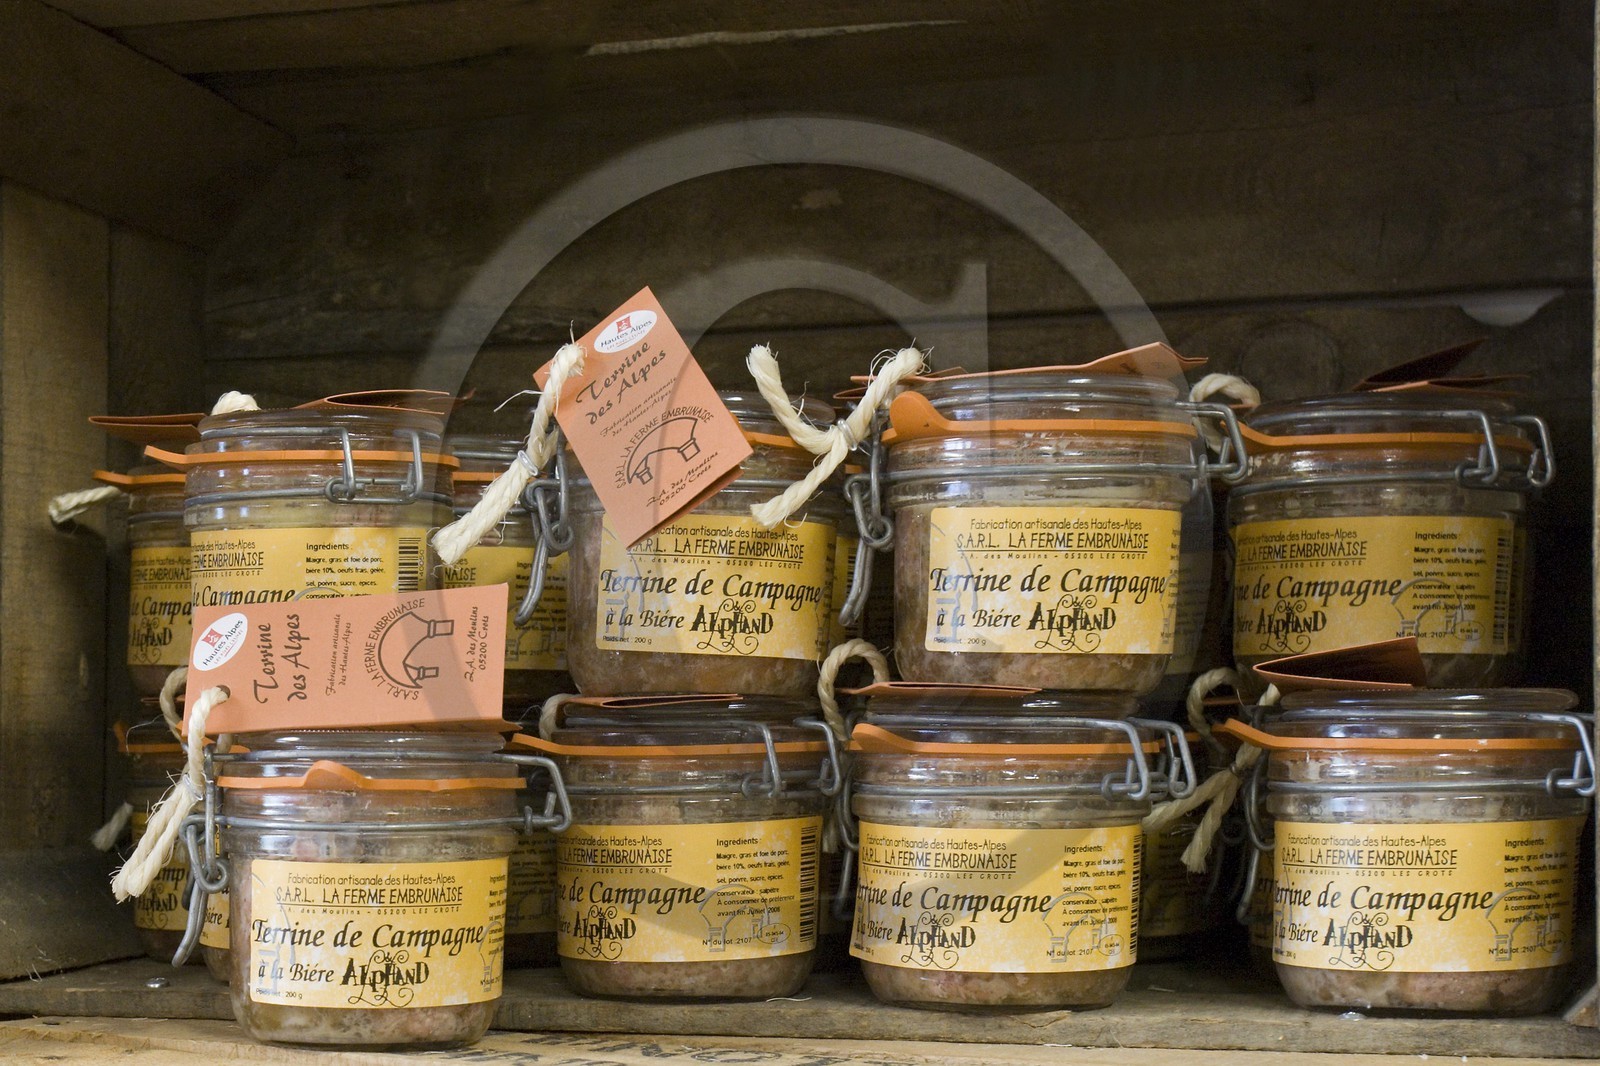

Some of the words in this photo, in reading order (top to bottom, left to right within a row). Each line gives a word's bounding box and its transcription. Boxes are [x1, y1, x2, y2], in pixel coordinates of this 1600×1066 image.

[600, 332, 629, 348] Hautes
[630, 320, 653, 335] Alpes
[575, 341, 651, 404] Terrine
[585, 398, 613, 424] des
[617, 350, 667, 404] Alpes
[600, 404, 642, 438] Fabrication
[643, 377, 677, 405] artisanale
[661, 406, 714, 424] EMBRUNAISE
[630, 418, 659, 444] FERME
[620, 446, 634, 459] LA
[615, 459, 627, 490] SARL
[684, 452, 719, 482] Moulins
[659, 484, 687, 506] 05200
[688, 464, 712, 484] Crots
[689, 525, 734, 538] artisanale
[735, 528, 750, 538] des
[751, 529, 798, 544] Hautes-Alpes
[970, 518, 1022, 531] Fabrication
[1024, 518, 1071, 530] artisanale
[1072, 518, 1089, 530] des
[1091, 518, 1142, 533] Hautes-Alpes
[1287, 531, 1300, 542] des
[1301, 528, 1358, 542] Hautes-Alpes
[214, 539, 256, 552] Hautes-Alpes
[674, 538, 693, 554] LA
[695, 539, 735, 556] FERME
[738, 539, 804, 560] EMBRUNAISE
[957, 533, 1000, 549] S.A.R.L.
[1008, 533, 1027, 549] LA
[1031, 533, 1074, 549] FERME
[1077, 533, 1149, 549] EMBRUNAISE
[1258, 545, 1287, 561] FERME
[1290, 541, 1367, 559] EMBRUNAISE
[208, 551, 265, 568] EMBRUNAISE
[600, 569, 677, 595] Terrine
[684, 569, 714, 596] de
[722, 574, 822, 611] Campagne
[930, 567, 1012, 592] Terrine
[1020, 564, 1051, 592] de
[1060, 568, 1167, 604] Campagne
[1252, 574, 1269, 600] de
[1277, 576, 1402, 607] Campagne
[368, 598, 426, 641] EMBRUNAISE
[467, 606, 478, 642] Moulins
[478, 615, 489, 640] Crots
[605, 607, 614, 626] à
[620, 607, 633, 626] la
[936, 608, 945, 626] à
[951, 606, 965, 626] la
[202, 641, 226, 666] Hautes
[224, 620, 243, 640] Alpes
[281, 613, 310, 670] Alpes
[253, 622, 279, 704] Terrine
[325, 653, 339, 697] Fabrication
[333, 613, 342, 650] artisanale
[364, 641, 378, 674] FERME
[479, 641, 488, 671] 05200
[287, 674, 308, 701] des
[371, 671, 386, 688] LA
[387, 682, 420, 701] SARL
[610, 835, 662, 849] Hautes-Alpes
[866, 833, 893, 847] Fabrication
[893, 837, 928, 849] artisanale
[930, 838, 945, 850] des
[947, 839, 1007, 853] Hautes-Alpes
[1288, 833, 1320, 846] Fabrication
[1321, 835, 1360, 847] artisanale
[1362, 836, 1379, 847] des
[1381, 835, 1447, 850] Hautes-Alpes
[574, 848, 599, 863] FERME
[601, 848, 672, 864] EMBRUNAISE
[885, 849, 896, 866] LA
[897, 850, 931, 868] FERME
[934, 853, 1017, 870] EMBRUNAISE
[1310, 849, 1323, 864] LA
[1326, 850, 1364, 865] FERME
[1367, 849, 1457, 866] EMBRUNAISE
[288, 873, 336, 885] Fabrication
[337, 873, 383, 886] artisanale
[384, 874, 400, 886] des
[403, 873, 456, 888] Hautes-Alpes
[277, 887, 314, 904] S.A.R.L.
[322, 887, 342, 904] LA
[343, 888, 386, 905] FERME
[389, 886, 463, 904] EMBRUNAISE
[569, 876, 584, 903] de
[589, 881, 706, 915] Campagne
[892, 881, 913, 908] de
[920, 886, 1052, 923] Campagne
[1317, 881, 1342, 908] de
[1350, 885, 1494, 922] Campagne
[252, 919, 326, 947] Terrine
[333, 920, 363, 948] de
[372, 924, 484, 959] Campagne
[258, 959, 265, 978] à
[270, 959, 283, 979] la
